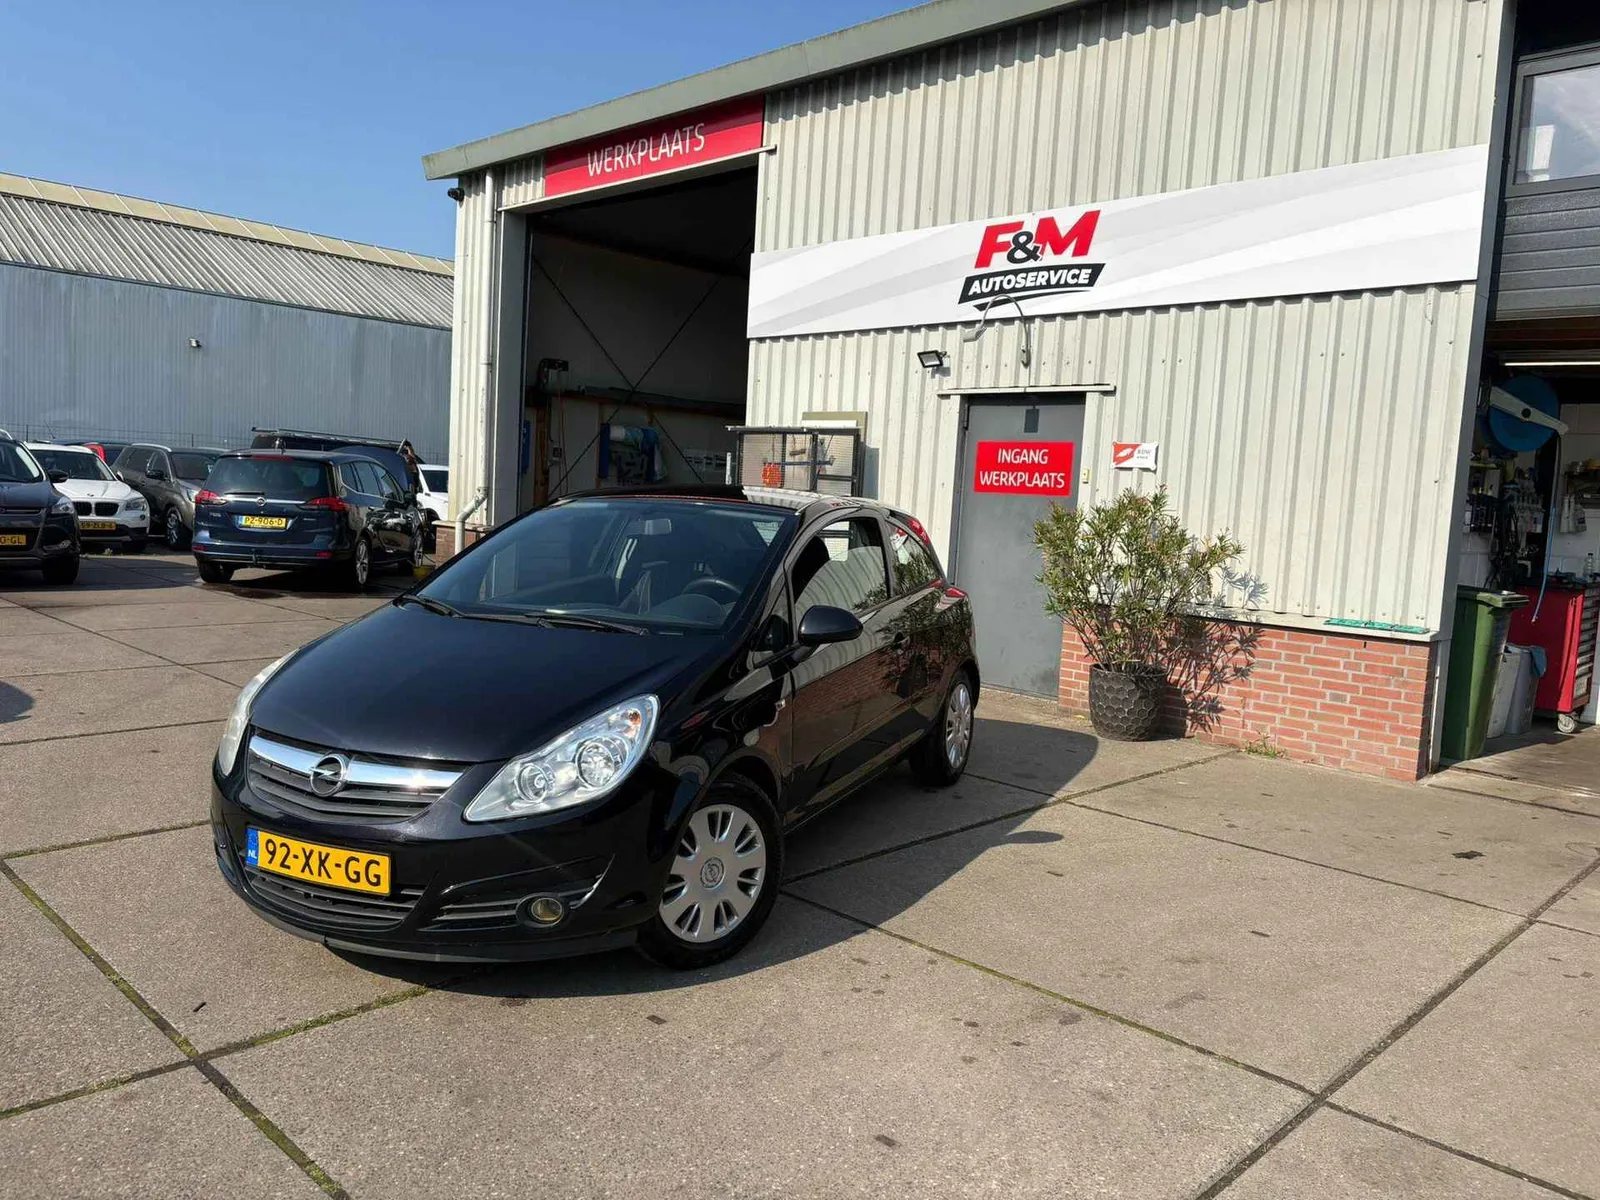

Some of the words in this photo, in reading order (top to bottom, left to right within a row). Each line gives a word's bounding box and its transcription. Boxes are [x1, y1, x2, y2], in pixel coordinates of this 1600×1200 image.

[587, 123, 705, 177] WERKPLAATS
[974, 210, 1101, 268] F&M
[968, 268, 1092, 295] AUTOSERVICE
[997, 448, 1049, 465] INGANG
[979, 471, 1065, 489] WERKPLAATS
[244, 516, 283, 526] PZ-906-D
[265, 838, 381, 887] 92-XK-GG
